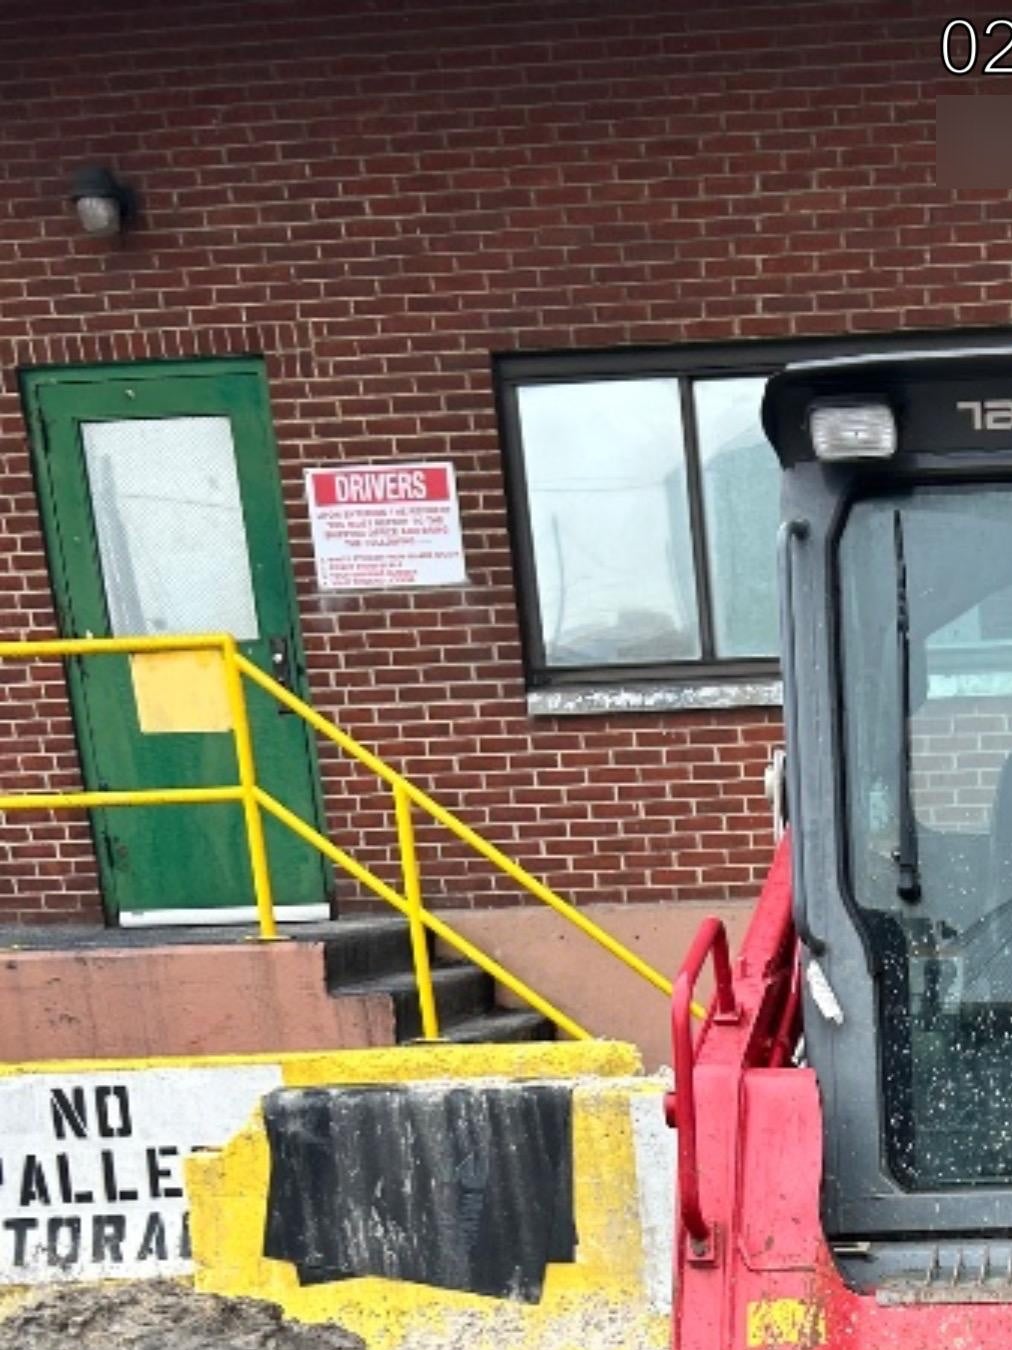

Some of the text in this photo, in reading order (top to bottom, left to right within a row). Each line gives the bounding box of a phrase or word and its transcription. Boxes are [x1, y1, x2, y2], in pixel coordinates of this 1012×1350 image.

[335, 470, 428, 502] DRIVERS
[50, 1085, 133, 1140] NO
[0, 1146, 208, 1207] ALLE
